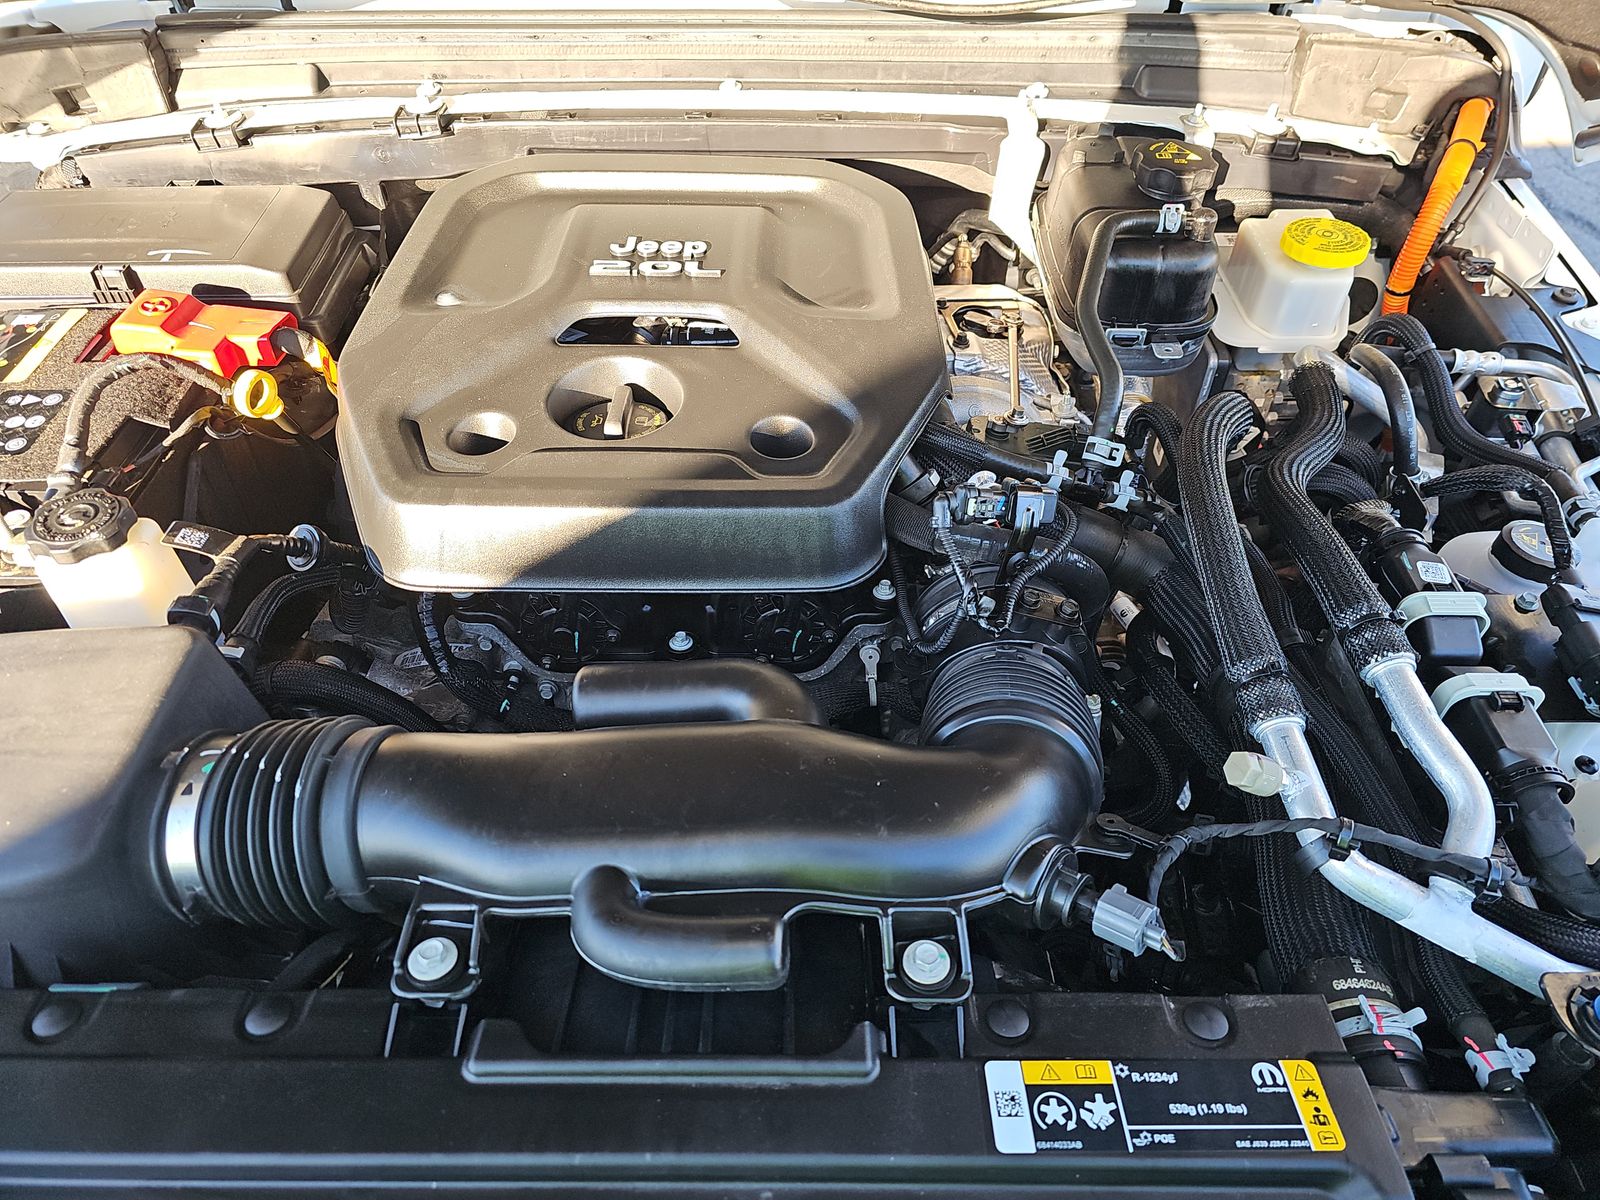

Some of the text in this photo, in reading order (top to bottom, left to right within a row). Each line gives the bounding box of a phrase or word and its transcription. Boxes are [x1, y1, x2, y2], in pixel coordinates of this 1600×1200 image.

[609, 235, 710, 260] Jeep
[589, 260, 725, 278] 2.0L
[1131, 1072, 1179, 1084] R-1234yf
[1197, 1103, 1224, 1116] (1.19
[1225, 1103, 1248, 1116] lbs)
[1153, 1133, 1177, 1143] POE
